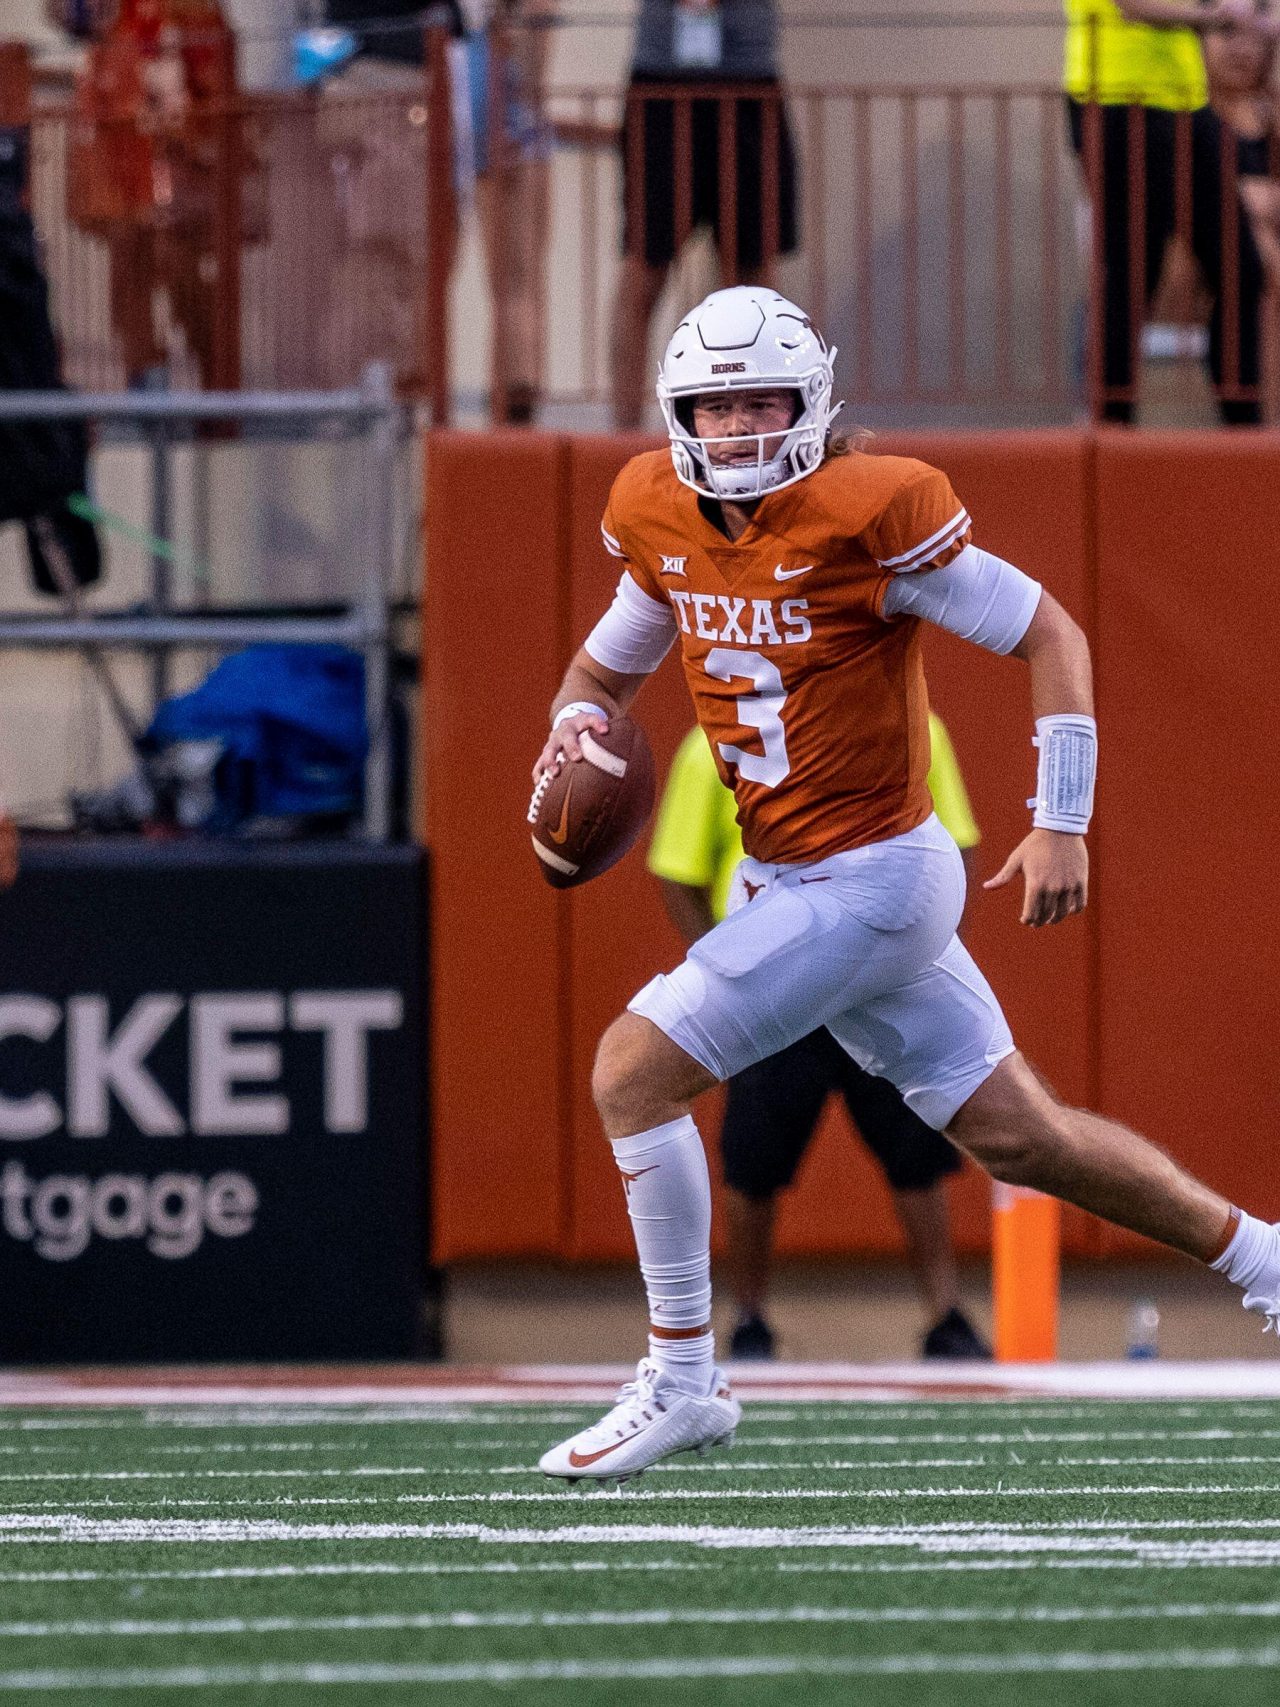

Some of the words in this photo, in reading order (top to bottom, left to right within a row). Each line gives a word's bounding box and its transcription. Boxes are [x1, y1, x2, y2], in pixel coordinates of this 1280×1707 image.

[711, 362, 746, 374] HORNS
[668, 588, 813, 645] TEXAS
[703, 647, 791, 789] 3
